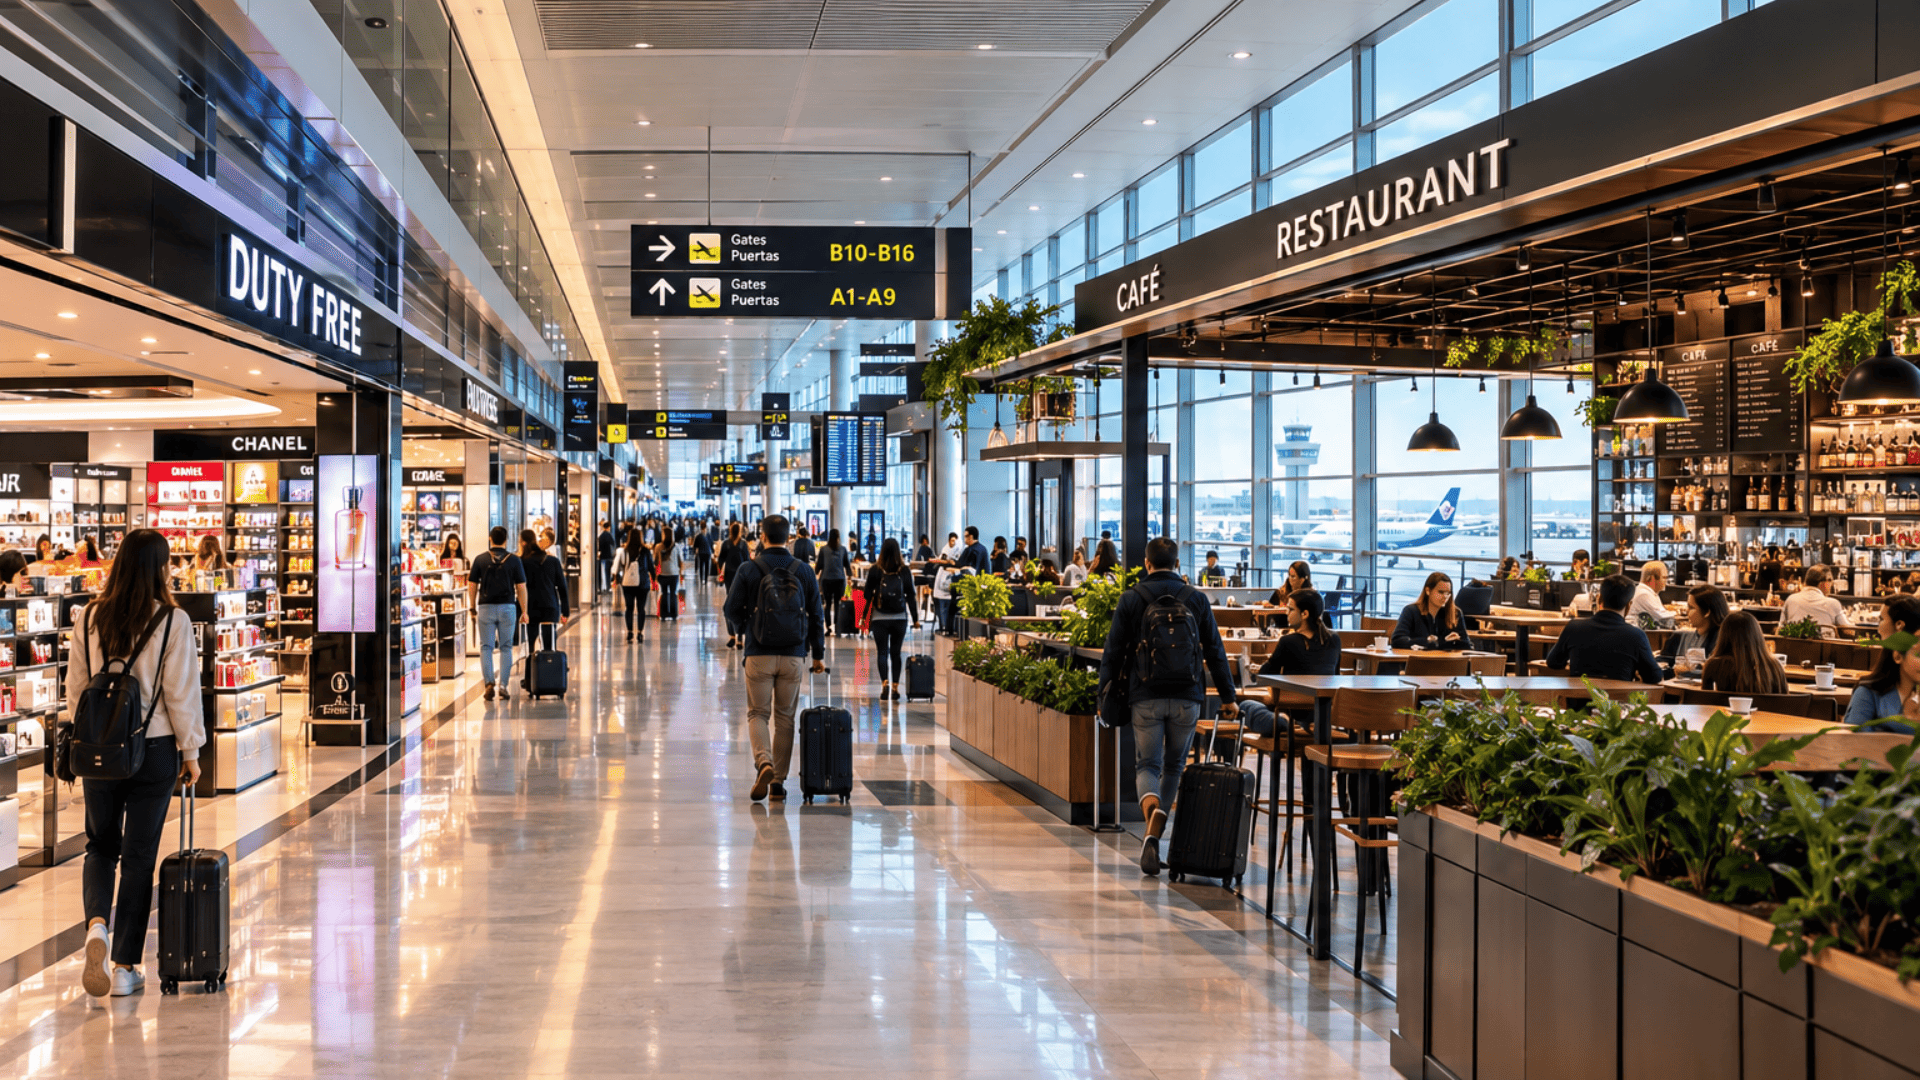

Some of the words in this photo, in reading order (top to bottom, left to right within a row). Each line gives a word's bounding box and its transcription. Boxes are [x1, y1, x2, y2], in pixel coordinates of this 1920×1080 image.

[1276, 138, 1511, 259] RESTAURANT
[730, 233, 767, 246] Gates
[730, 249, 780, 263] Puertas
[829, 243, 915, 263] B10-B16
[730, 278, 767, 291] Gates
[1116, 264, 1161, 313] CAFÉ
[229, 233, 304, 328] DUTY
[311, 282, 362, 356] FREE
[730, 294, 780, 307] Puertas
[829, 287, 896, 307] A1-A9
[231, 435, 308, 452] CHANEL
